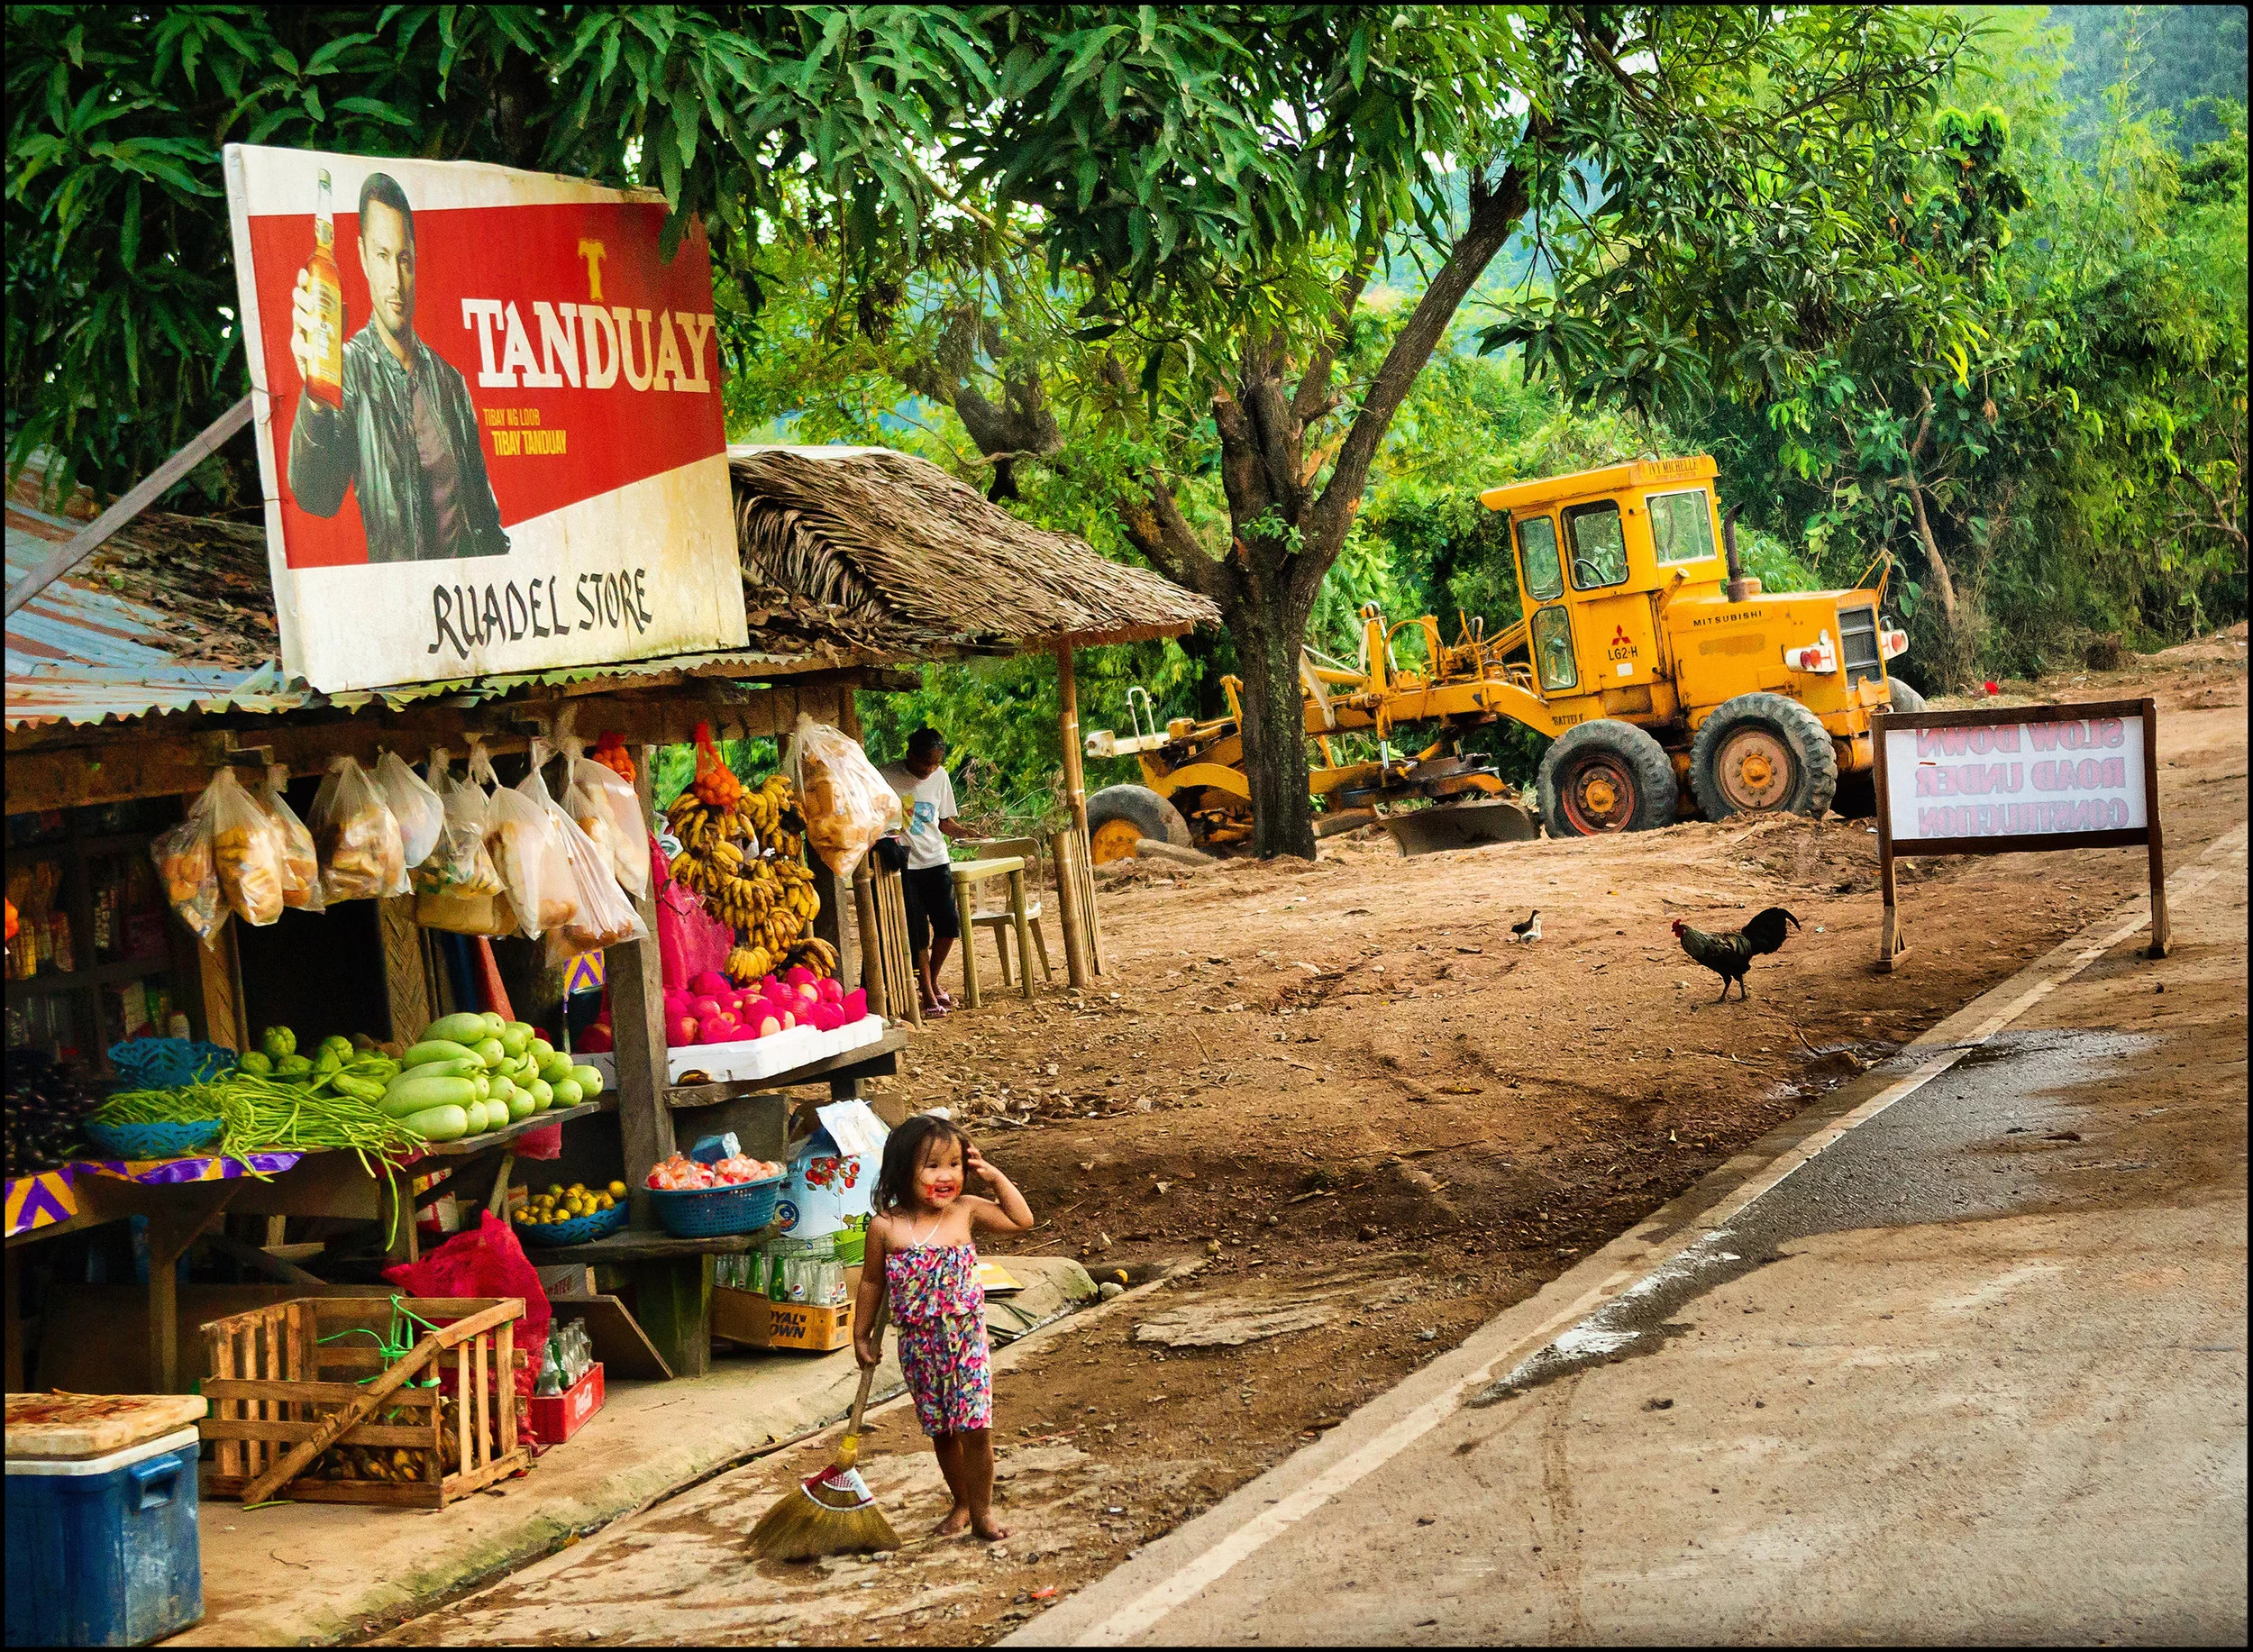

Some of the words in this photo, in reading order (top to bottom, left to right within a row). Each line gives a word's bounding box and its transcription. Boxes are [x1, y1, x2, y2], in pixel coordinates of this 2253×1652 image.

[461, 298, 716, 393] TANDUAY
[483, 408, 505, 426] TIBAY
[506, 408, 519, 426] NG
[519, 408, 541, 426] LOOB
[491, 430, 521, 456] TIBAY
[521, 429, 567, 455] TANDUAY
[1662, 458, 1699, 473] MICHELLE
[427, 574, 570, 661] RUADEL
[576, 568, 652, 635] STORE
[1692, 609, 1763, 627] MITSUBISHI
[1608, 645, 1638, 661] LG2-H
